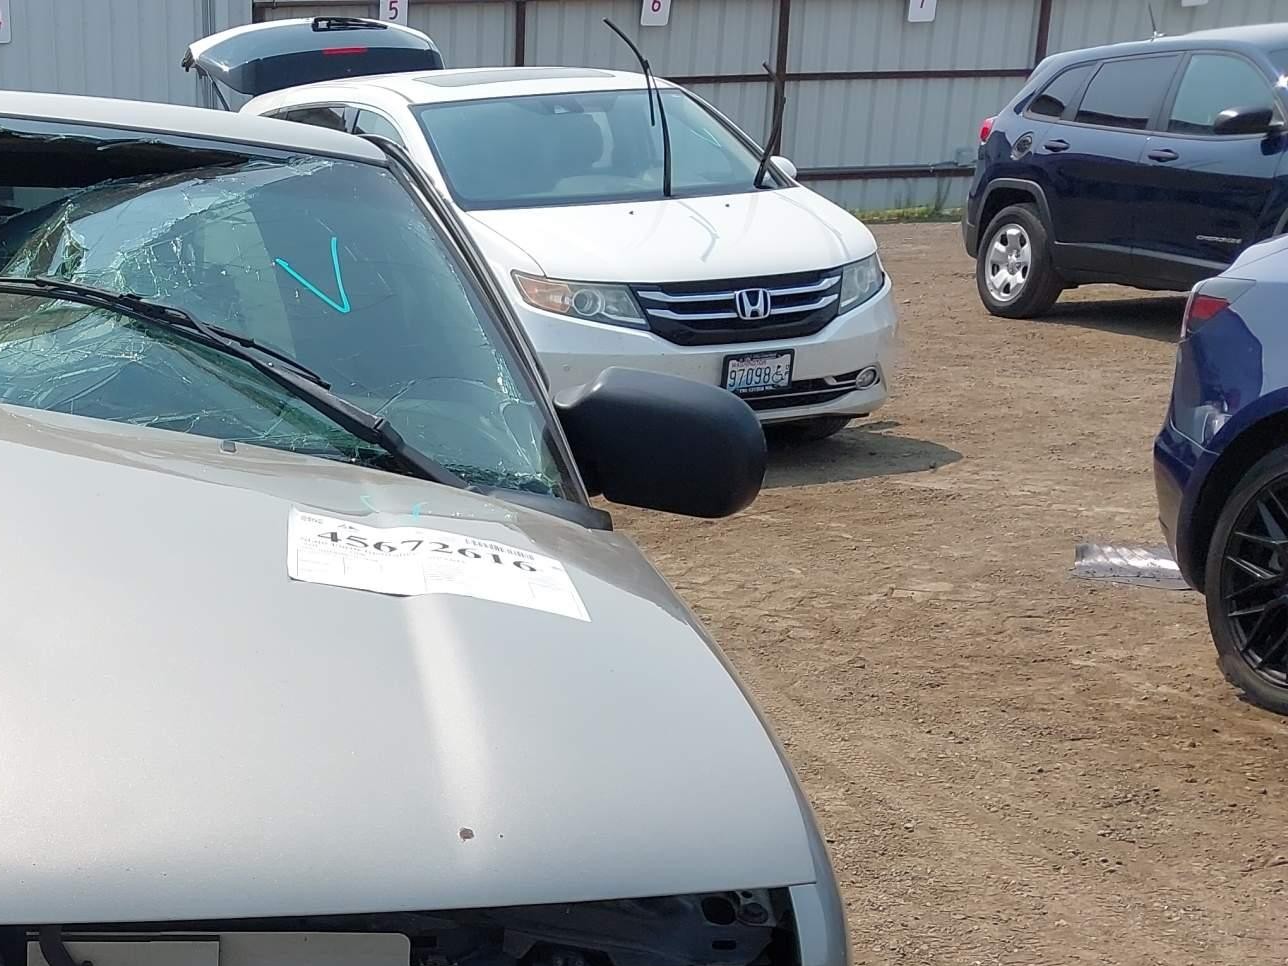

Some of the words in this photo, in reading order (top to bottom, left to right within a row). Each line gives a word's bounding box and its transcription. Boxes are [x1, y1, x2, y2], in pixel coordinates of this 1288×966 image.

[389, 0, 398, 20] 5
[729, 366, 771, 387] 97098
[317, 531, 537, 572] 45672616
